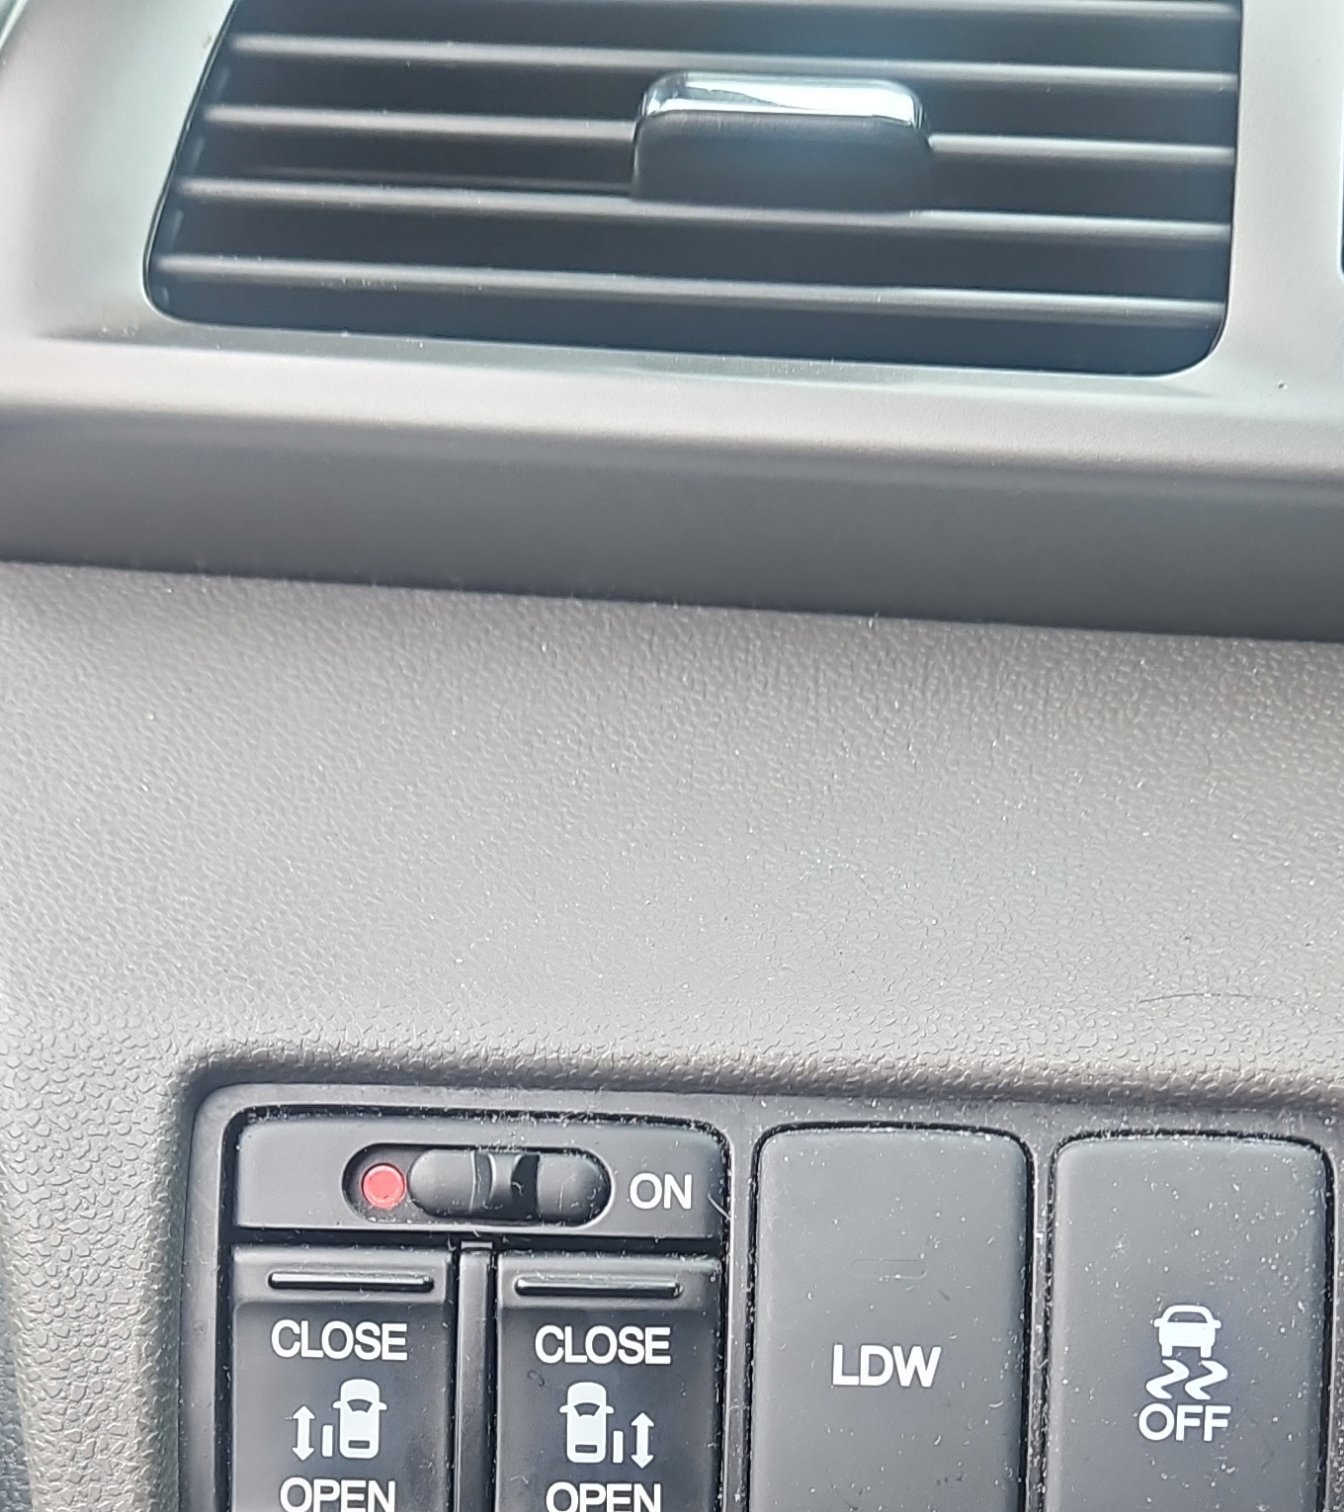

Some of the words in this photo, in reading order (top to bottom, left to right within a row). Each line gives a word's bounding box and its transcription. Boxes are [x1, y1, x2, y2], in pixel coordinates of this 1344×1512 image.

[629, 1172, 693, 1211] ON
[270, 1319, 408, 1361] CLOSE
[534, 1325, 672, 1365] CLOSE
[831, 1343, 942, 1388] LDW
[1137, 1402, 1232, 1442] OFF
